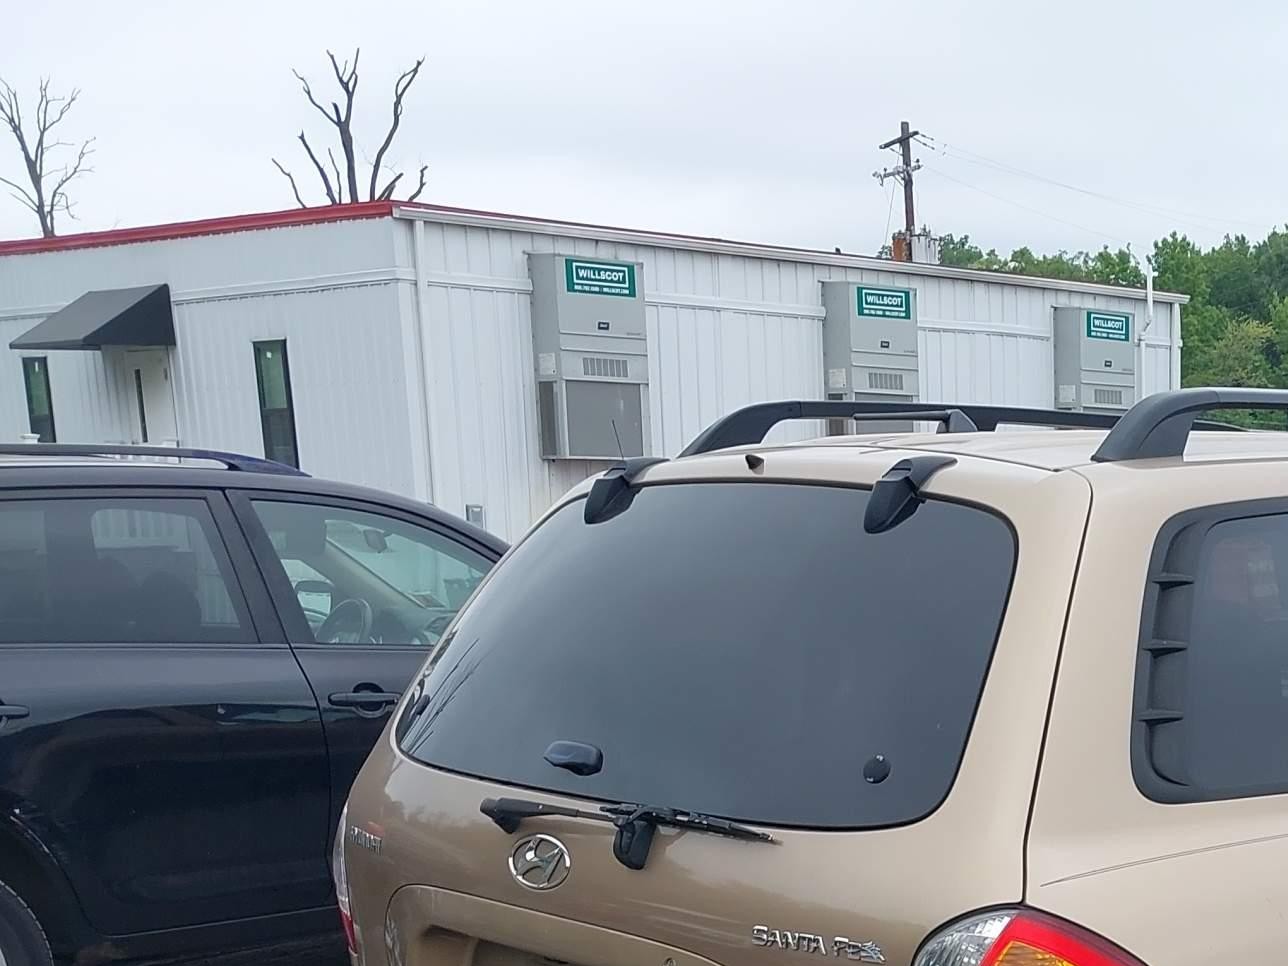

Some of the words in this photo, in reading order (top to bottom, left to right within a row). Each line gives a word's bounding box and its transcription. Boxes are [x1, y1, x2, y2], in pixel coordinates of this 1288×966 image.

[577, 268, 624, 282] WILLSCOT
[866, 294, 902, 306] WILLSCOT
[1093, 318, 1123, 330] WILLSCOT
[752, 925, 827, 955] SANTA
